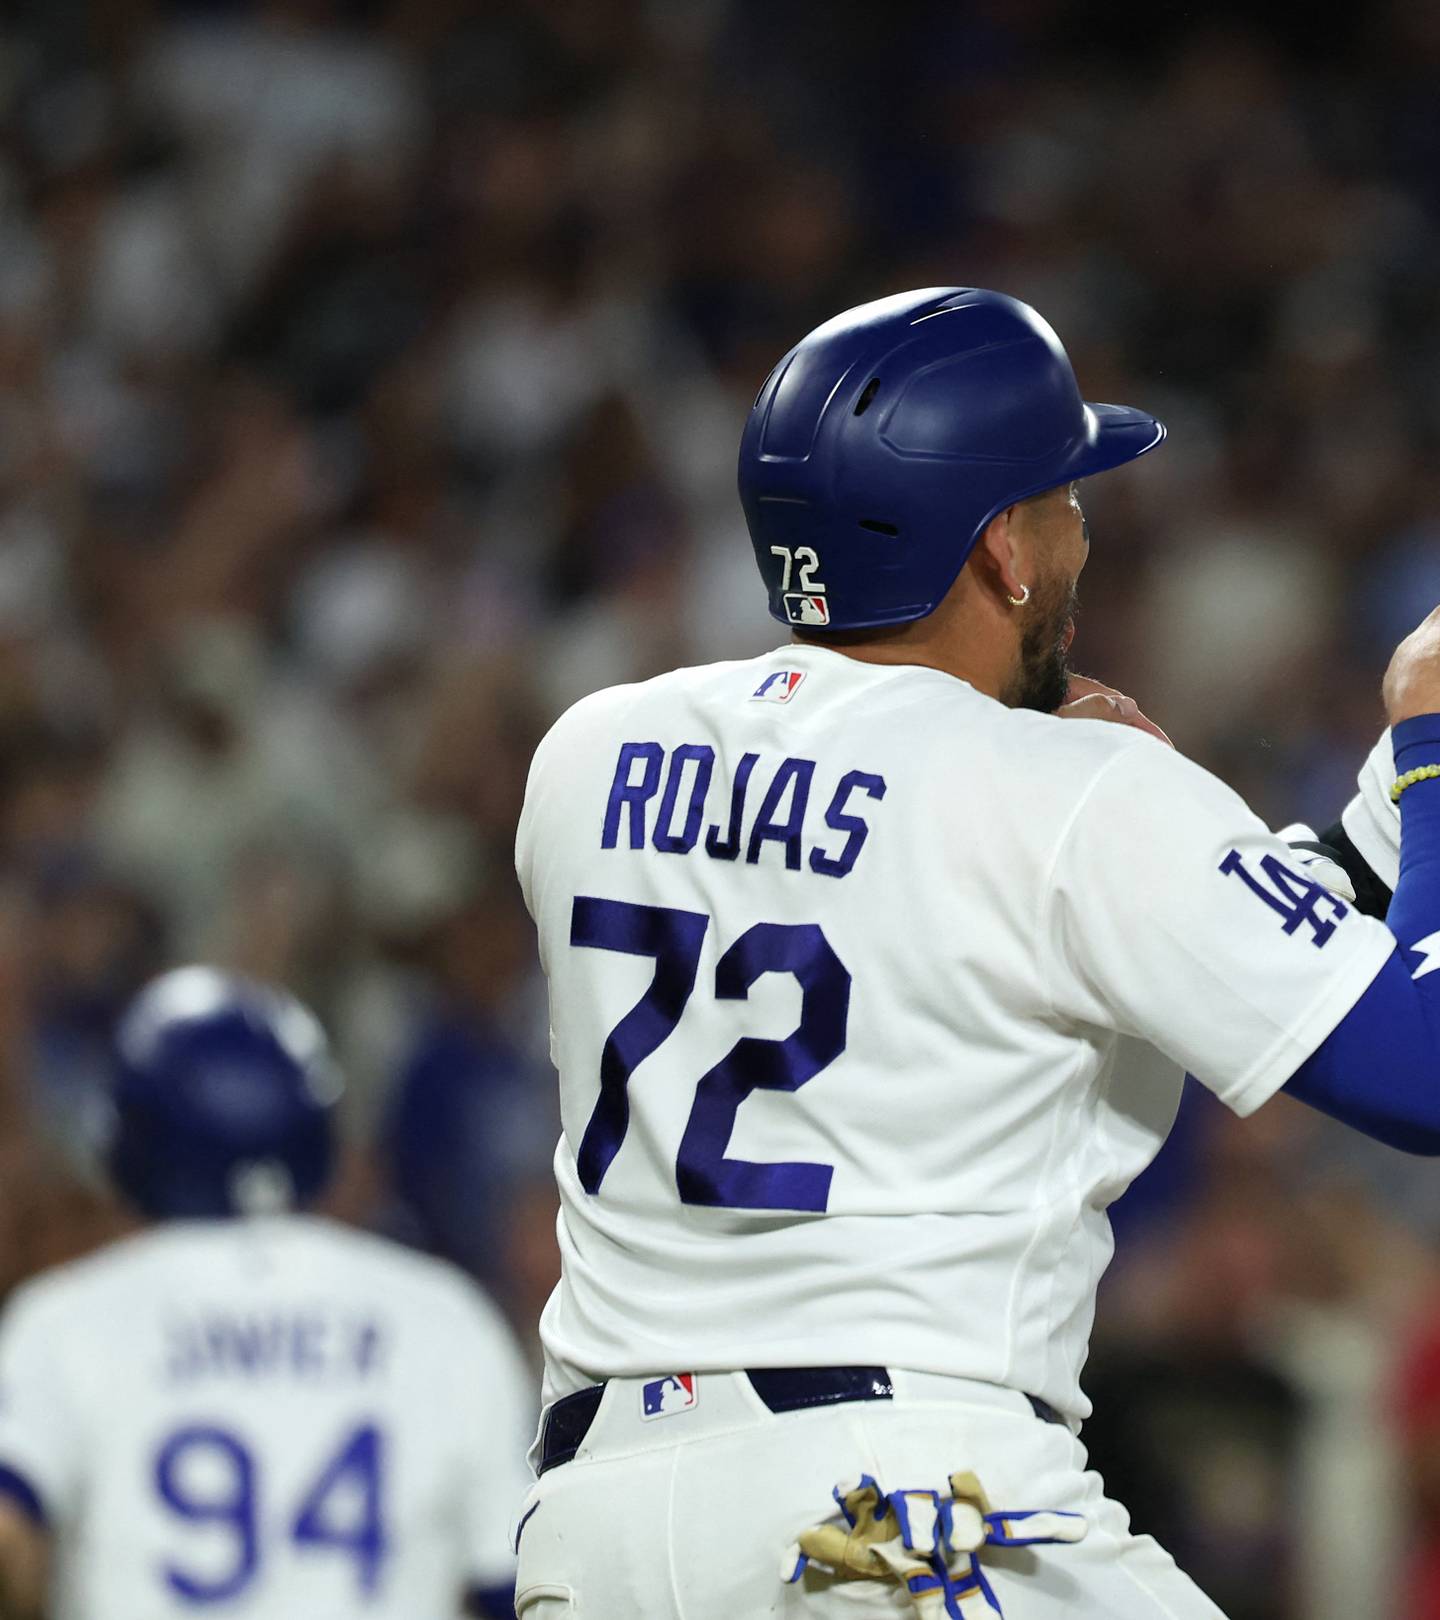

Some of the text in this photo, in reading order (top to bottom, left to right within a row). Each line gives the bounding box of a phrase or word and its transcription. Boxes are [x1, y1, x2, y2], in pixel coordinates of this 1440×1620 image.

[770, 545, 826, 593] 72
[600, 741, 888, 879] ROJAS
[1218, 848, 1349, 950] LA
[569, 895, 852, 1213] 72
[154, 1420, 388, 1608] 94
